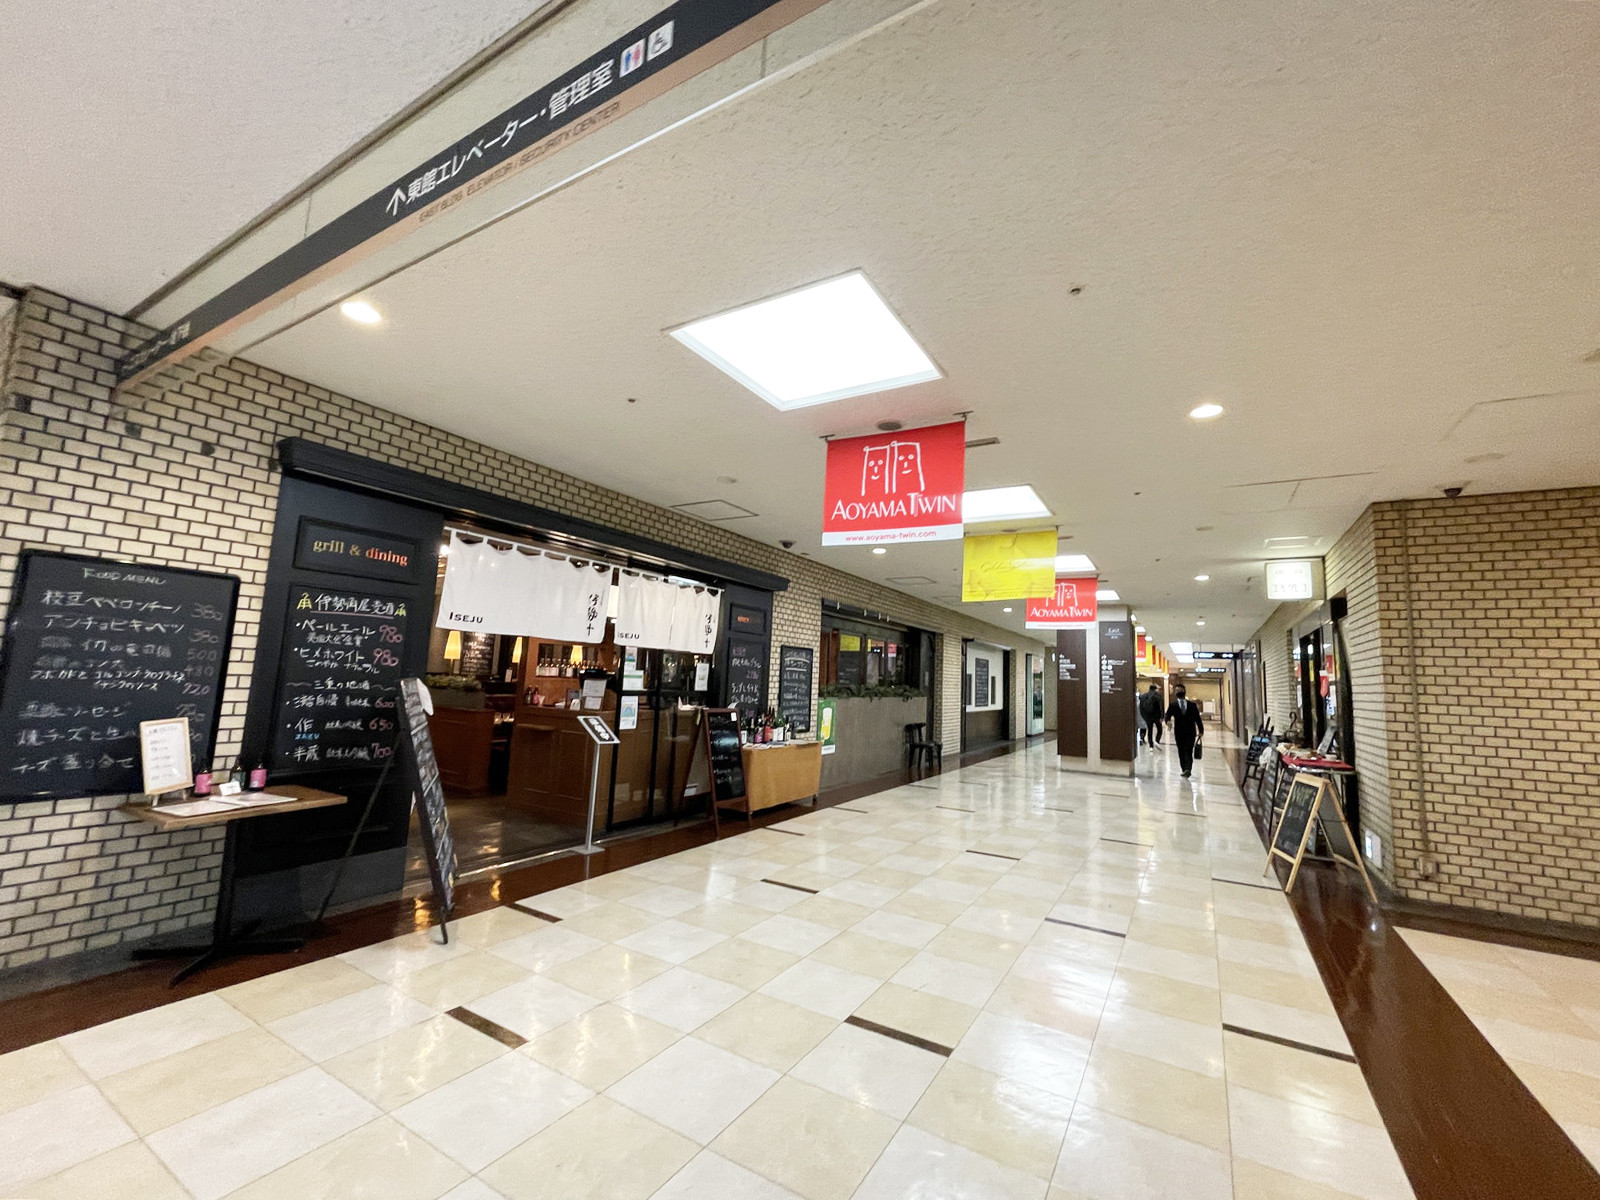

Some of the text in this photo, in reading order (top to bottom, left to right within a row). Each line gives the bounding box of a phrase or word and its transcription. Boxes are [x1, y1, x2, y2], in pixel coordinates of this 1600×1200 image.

[845, 530, 937, 542] www.aoyama-twin.com
[313, 540, 408, 567] grill & dining
